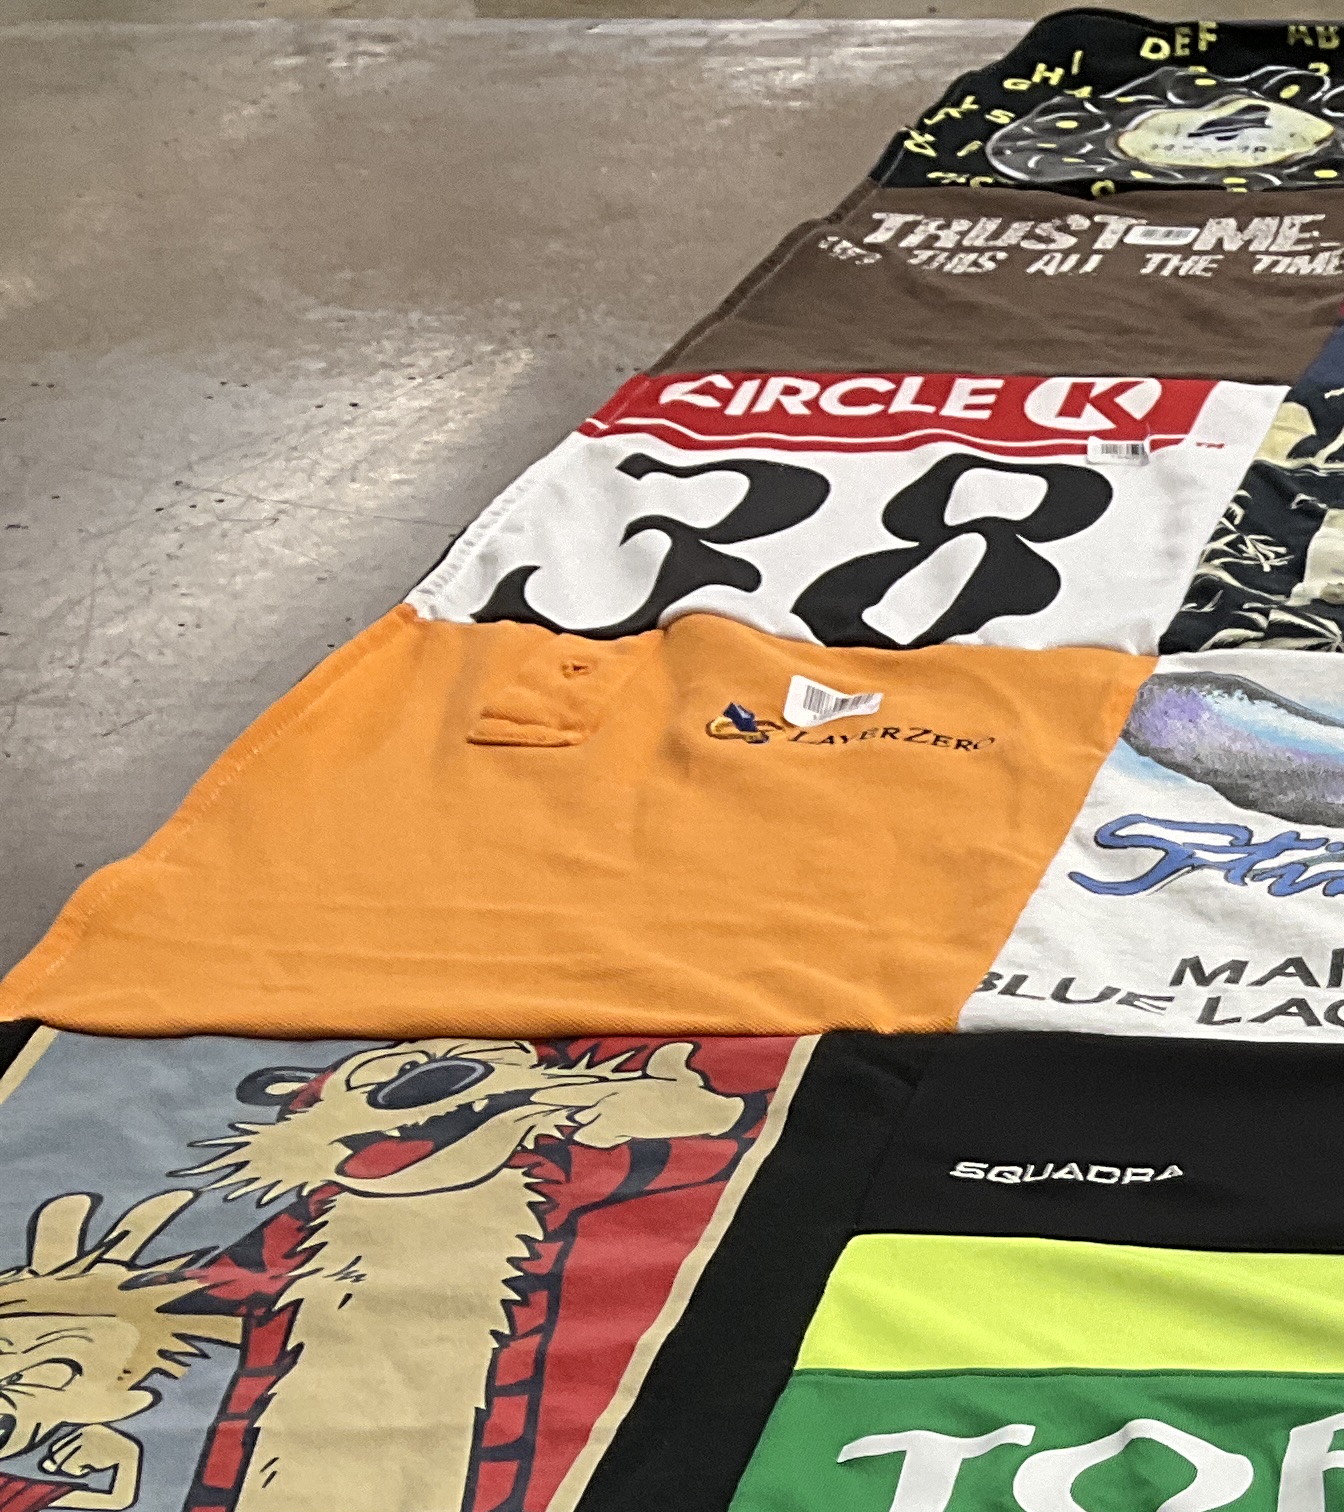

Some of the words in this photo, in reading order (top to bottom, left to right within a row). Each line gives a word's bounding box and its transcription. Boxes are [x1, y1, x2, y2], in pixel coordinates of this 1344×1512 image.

[1140, 21, 1217, 60] DEF
[1003, 50, 1083, 90] GHI
[863, 212, 1147, 250] TRUST
[1140, 252, 1225, 277] THE
[659, 374, 1005, 420] CIRCLE
[1042, 377, 1155, 431] K
[471, 451, 1114, 648] 38
[973, 970, 1175, 1015] BLUE
[949, 1160, 1185, 1185] SQUADRA
